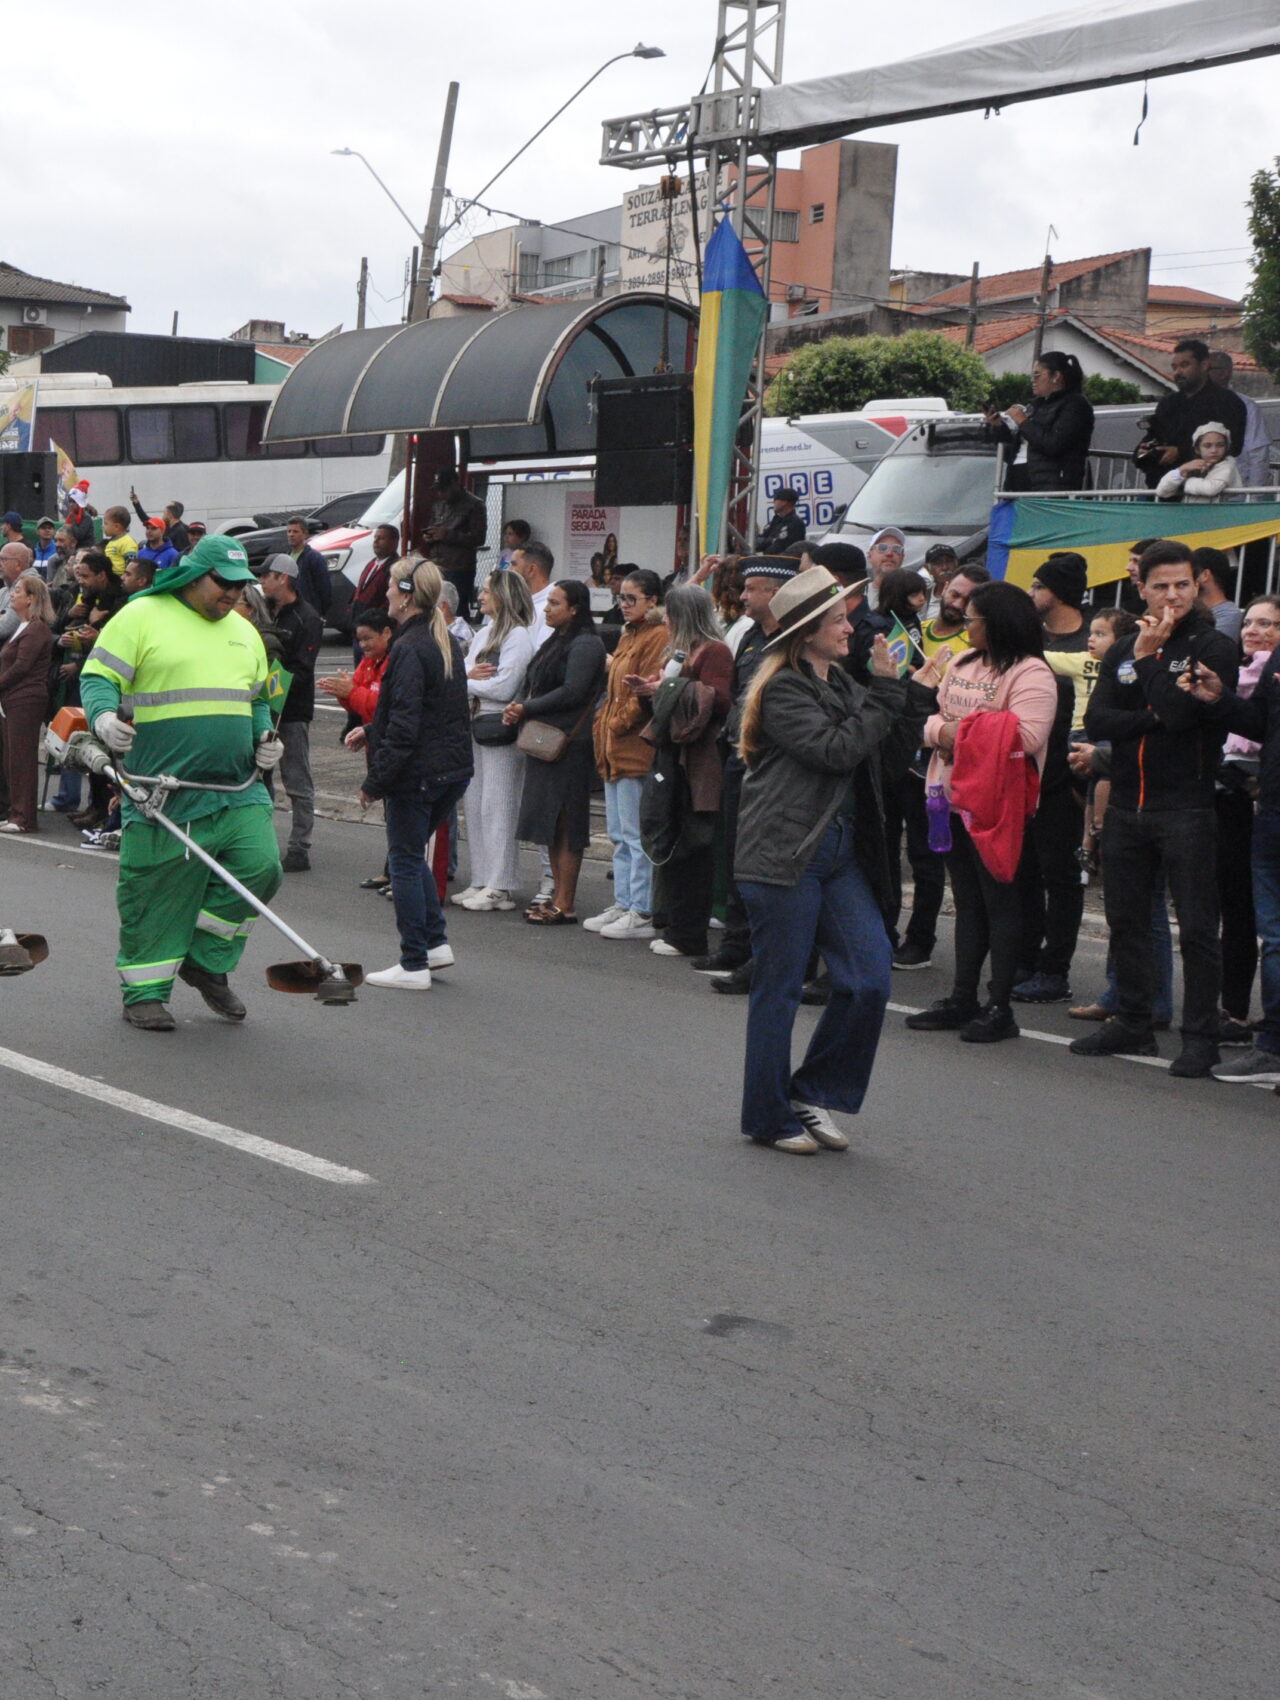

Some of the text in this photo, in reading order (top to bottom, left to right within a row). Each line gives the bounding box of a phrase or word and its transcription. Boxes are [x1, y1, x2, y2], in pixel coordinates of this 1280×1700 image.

[765, 470, 833, 499] PRE
[571, 509, 606, 519] PARADA
[571, 521, 605, 531] SEGURA
